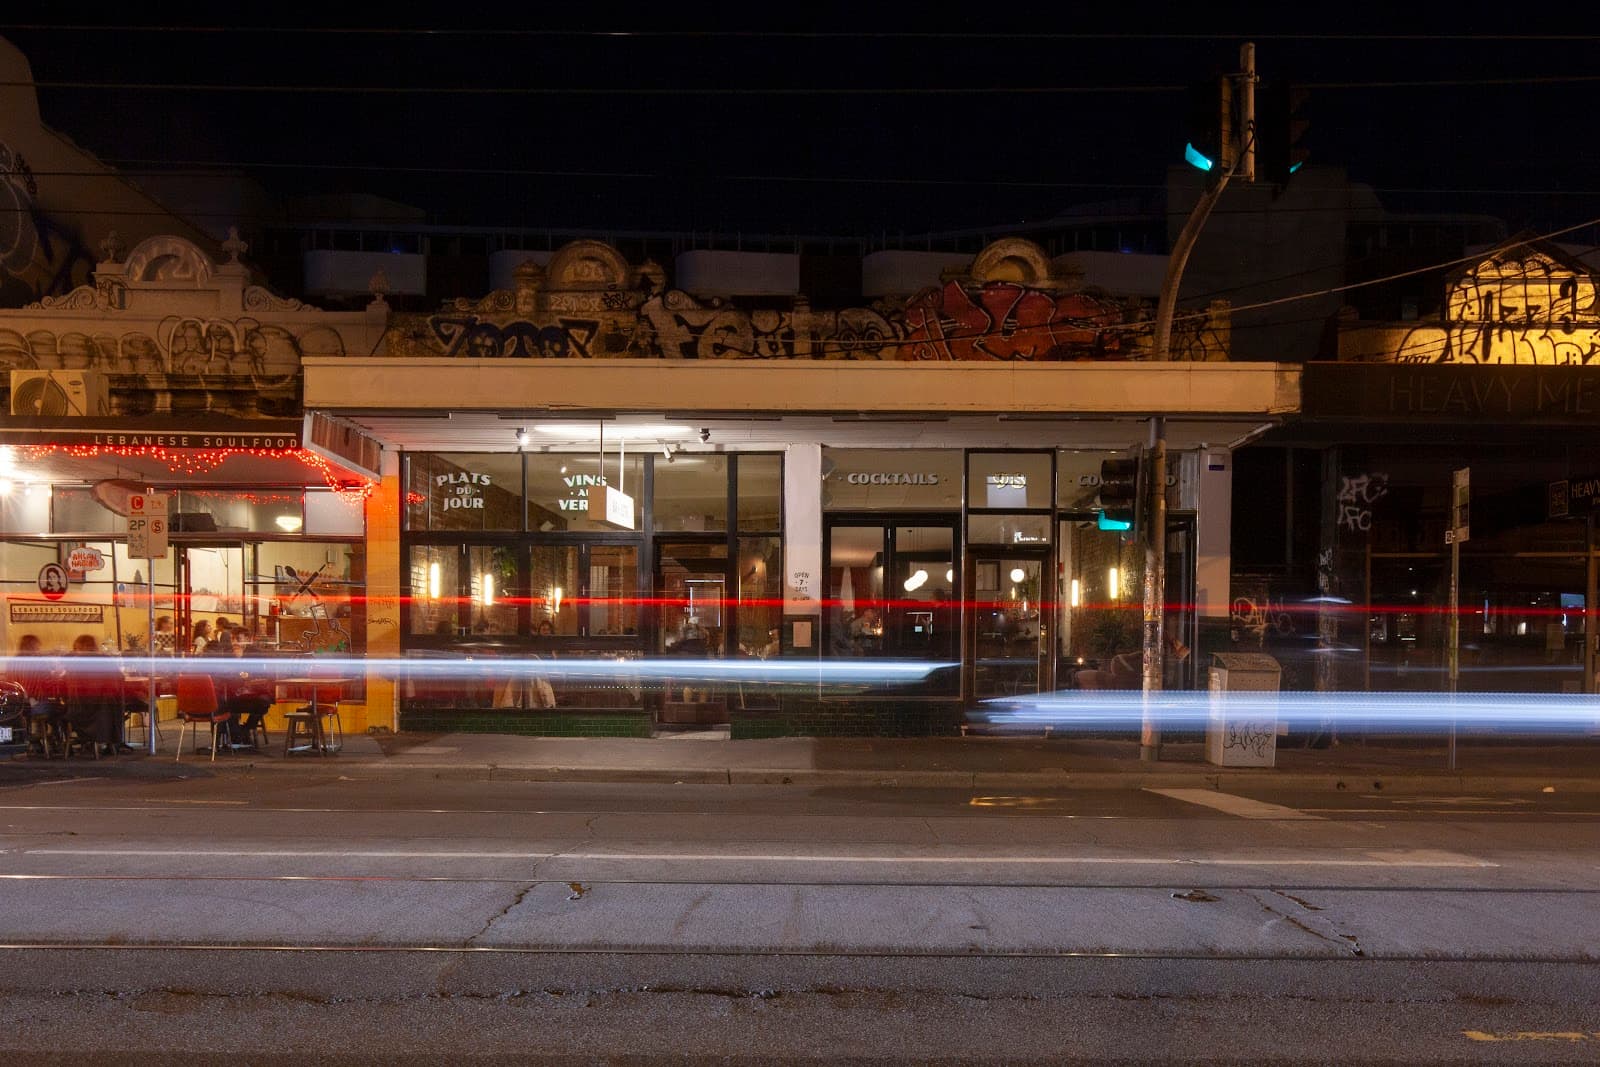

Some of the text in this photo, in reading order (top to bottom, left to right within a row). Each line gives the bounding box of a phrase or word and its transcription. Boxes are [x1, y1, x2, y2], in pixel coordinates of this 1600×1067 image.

[1388, 375, 1521, 413] HEAVY
[94, 435, 298, 449] LEBANESE SOULFOOD
[435, 471, 491, 488] PLATS
[562, 474, 608, 488] VINS
[847, 472, 939, 485] COCKTAILS
[455, 486, 472, 495] DU
[443, 497, 484, 512] JOUR
[129, 520, 146, 531] 2P
